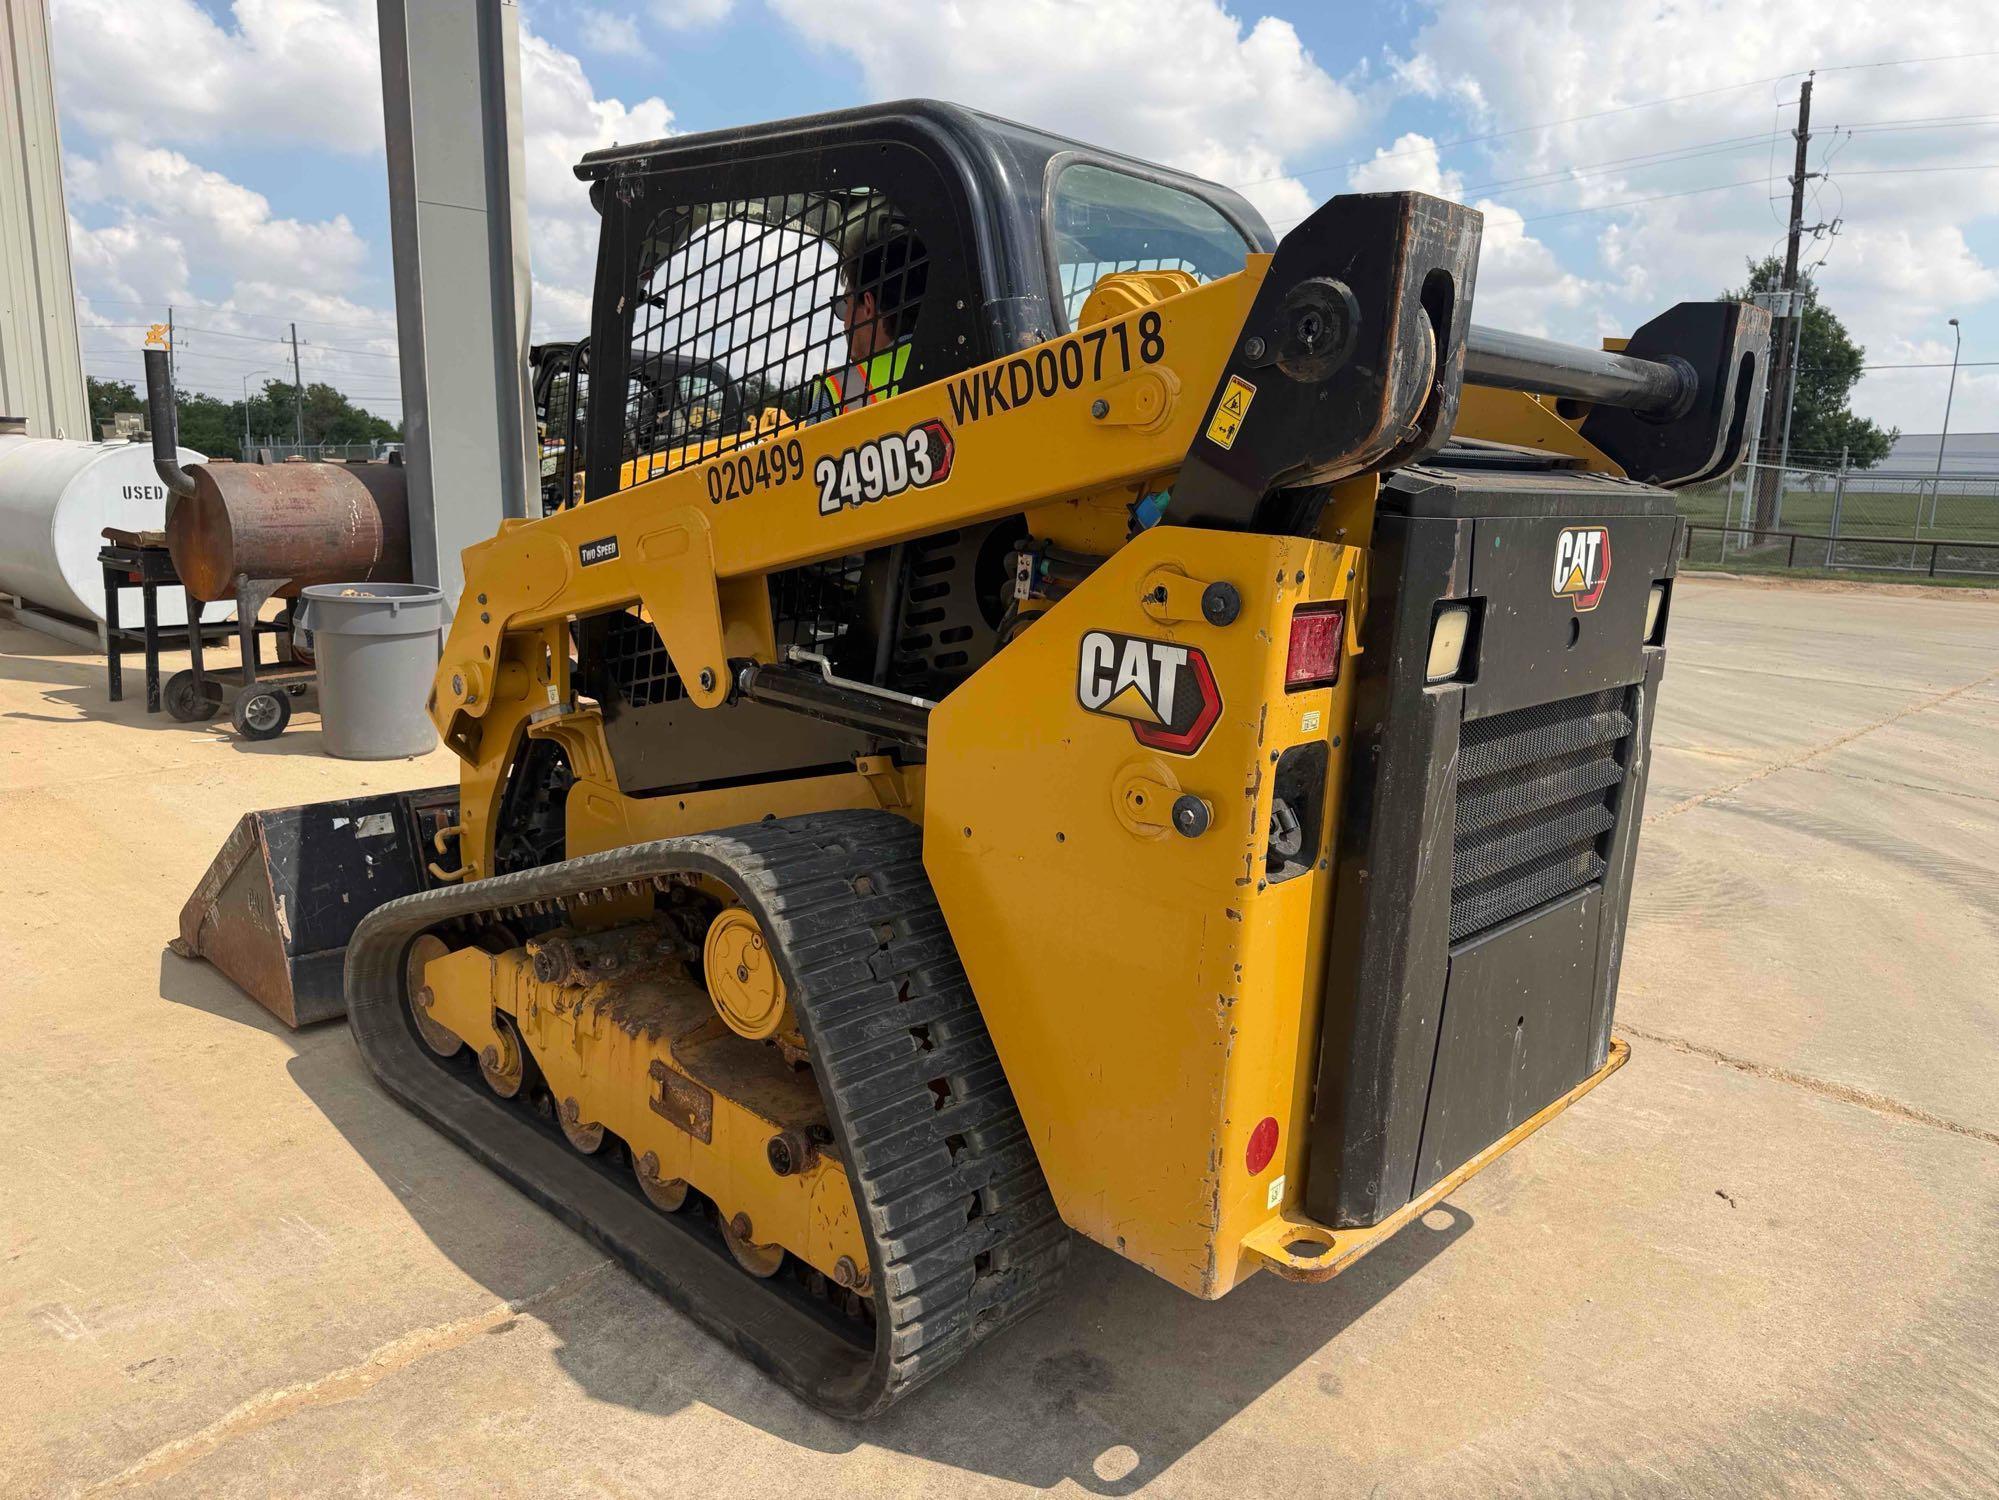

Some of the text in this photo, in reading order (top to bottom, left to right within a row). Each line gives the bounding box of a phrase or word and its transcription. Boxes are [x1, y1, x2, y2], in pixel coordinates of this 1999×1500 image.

[947, 311, 1165, 426] WKD00718
[122, 485, 163, 500] USED
[707, 438, 804, 504] 020499
[816, 429, 933, 513] 249D3
[1554, 531, 1602, 593] CAT
[1080, 632, 1188, 726] CAT
